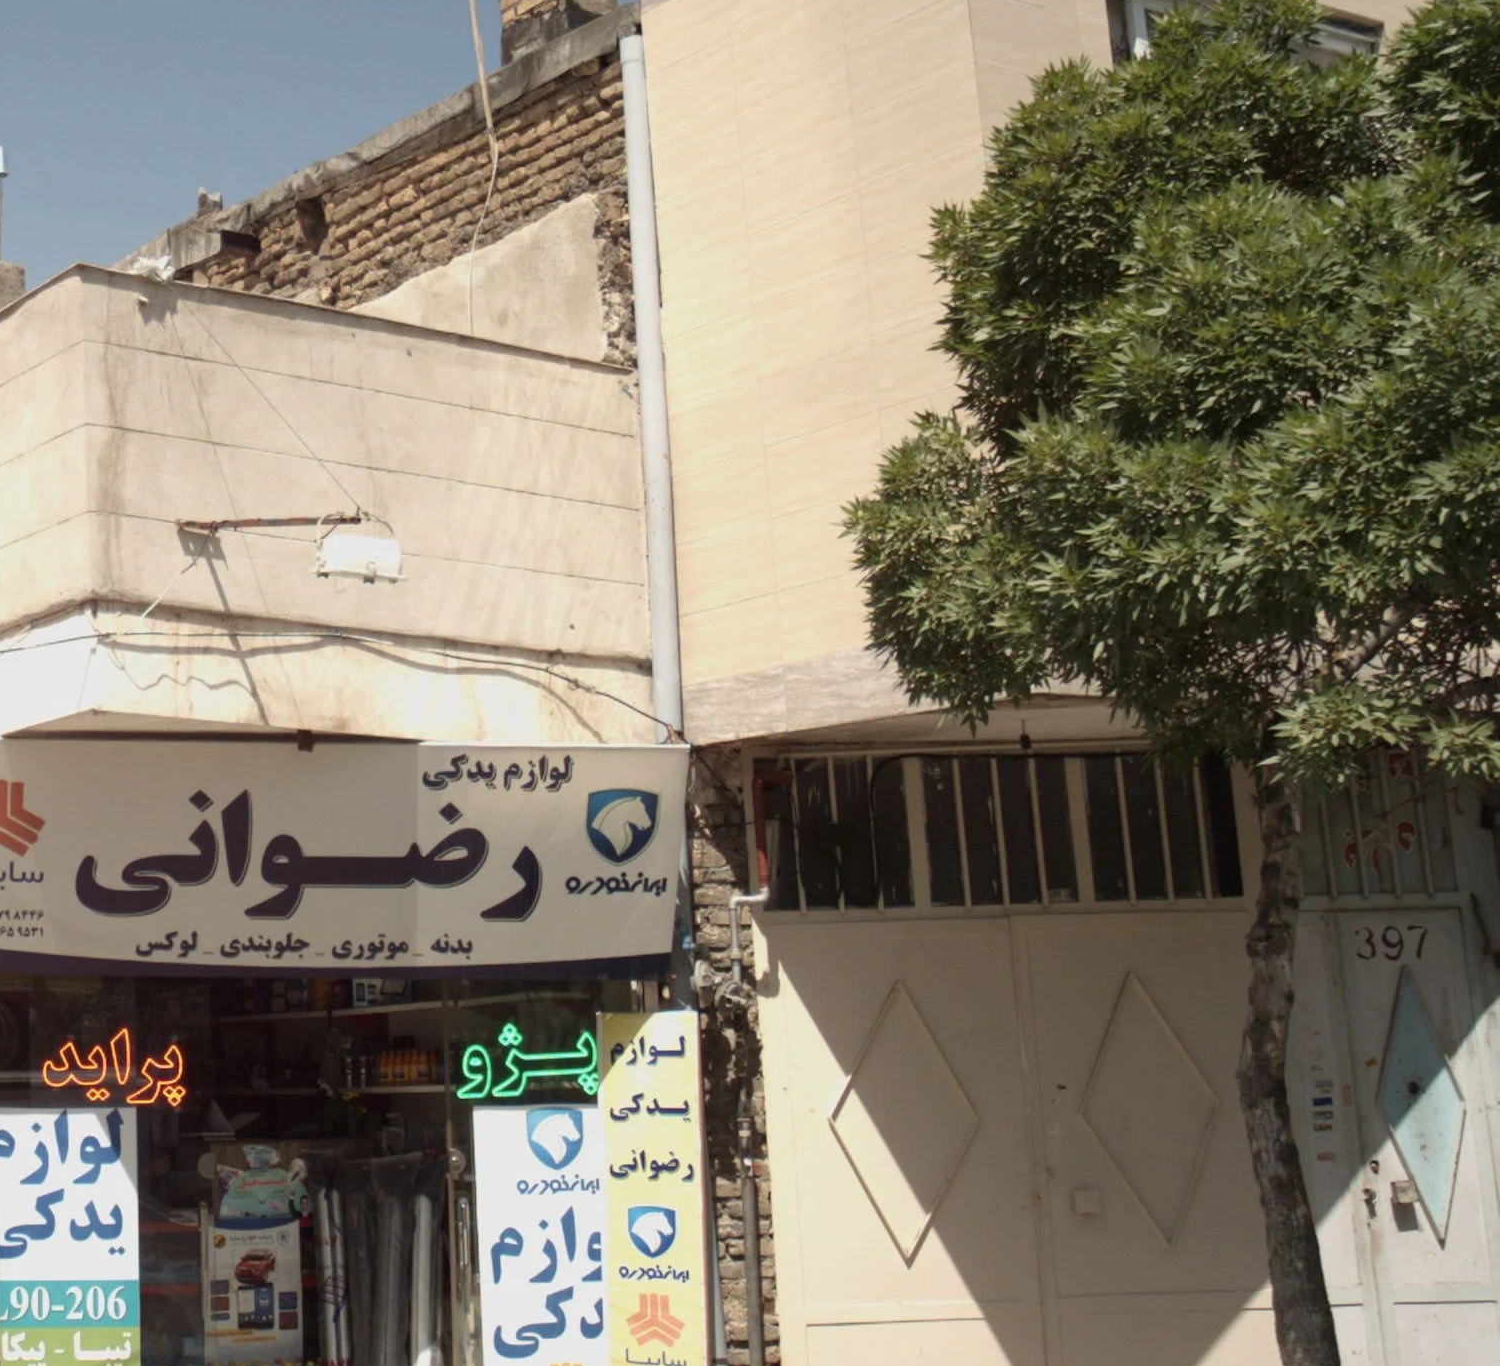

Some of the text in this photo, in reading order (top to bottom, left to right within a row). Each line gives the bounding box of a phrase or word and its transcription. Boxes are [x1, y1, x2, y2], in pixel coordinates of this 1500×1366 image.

[422, 753, 574, 791] لوازم یدکی
[75, 788, 542, 922] رضوانی
[135, 930, 199, 958] لوکس
[219, 931, 310, 960] جلوبندی
[331, 933, 409, 960] موتوری
[430, 934, 473, 960] بدنه
[1354, 924, 1429, 961] 397
[455, 1021, 599, 1099] پژو
[609, 1034, 686, 1065] لوازم
[42, 1027, 186, 1107] پراید
[609, 1092, 691, 1123] یدکی
[609, 1149, 695, 1181] رضوانی
